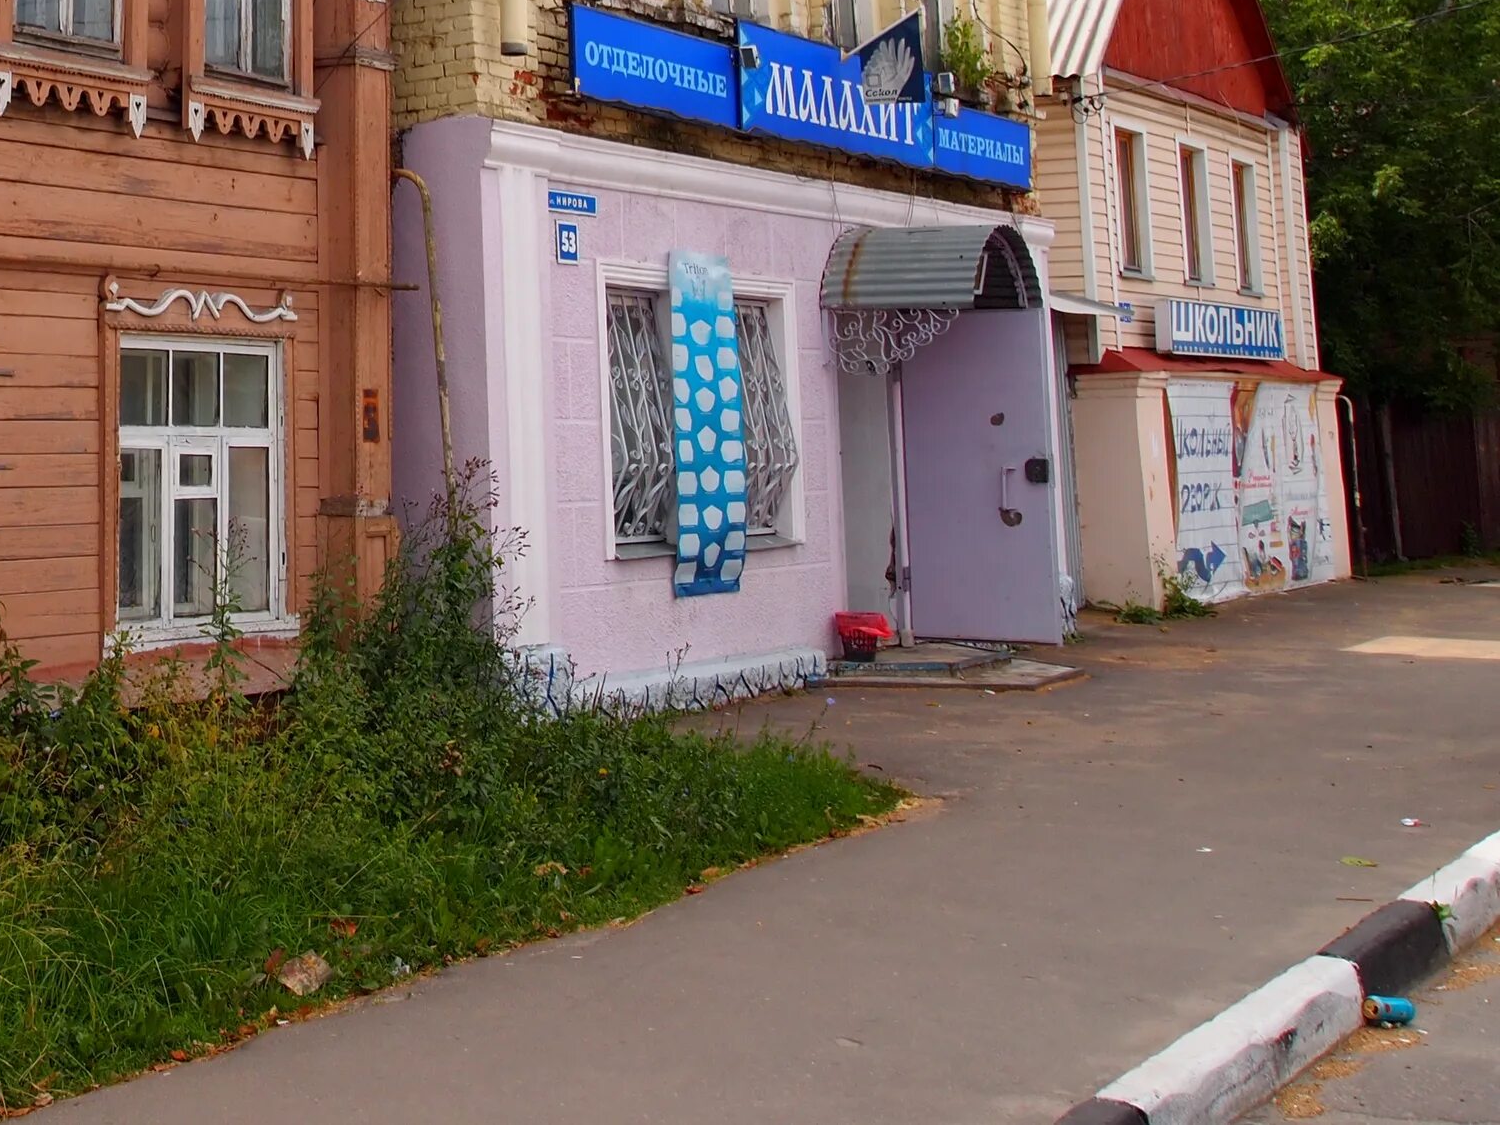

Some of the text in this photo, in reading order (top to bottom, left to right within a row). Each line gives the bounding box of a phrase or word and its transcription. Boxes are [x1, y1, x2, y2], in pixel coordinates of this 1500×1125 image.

[584, 40, 727, 98] ОТДЕЛОЧНЫЕ
[765, 61, 922, 146] МАЛАХИТ
[938, 127, 1025, 166] МАТЕРИАЛЫ
[561, 230, 576, 254] 53
[1172, 300, 1279, 348] ШКОЛЬНИК
